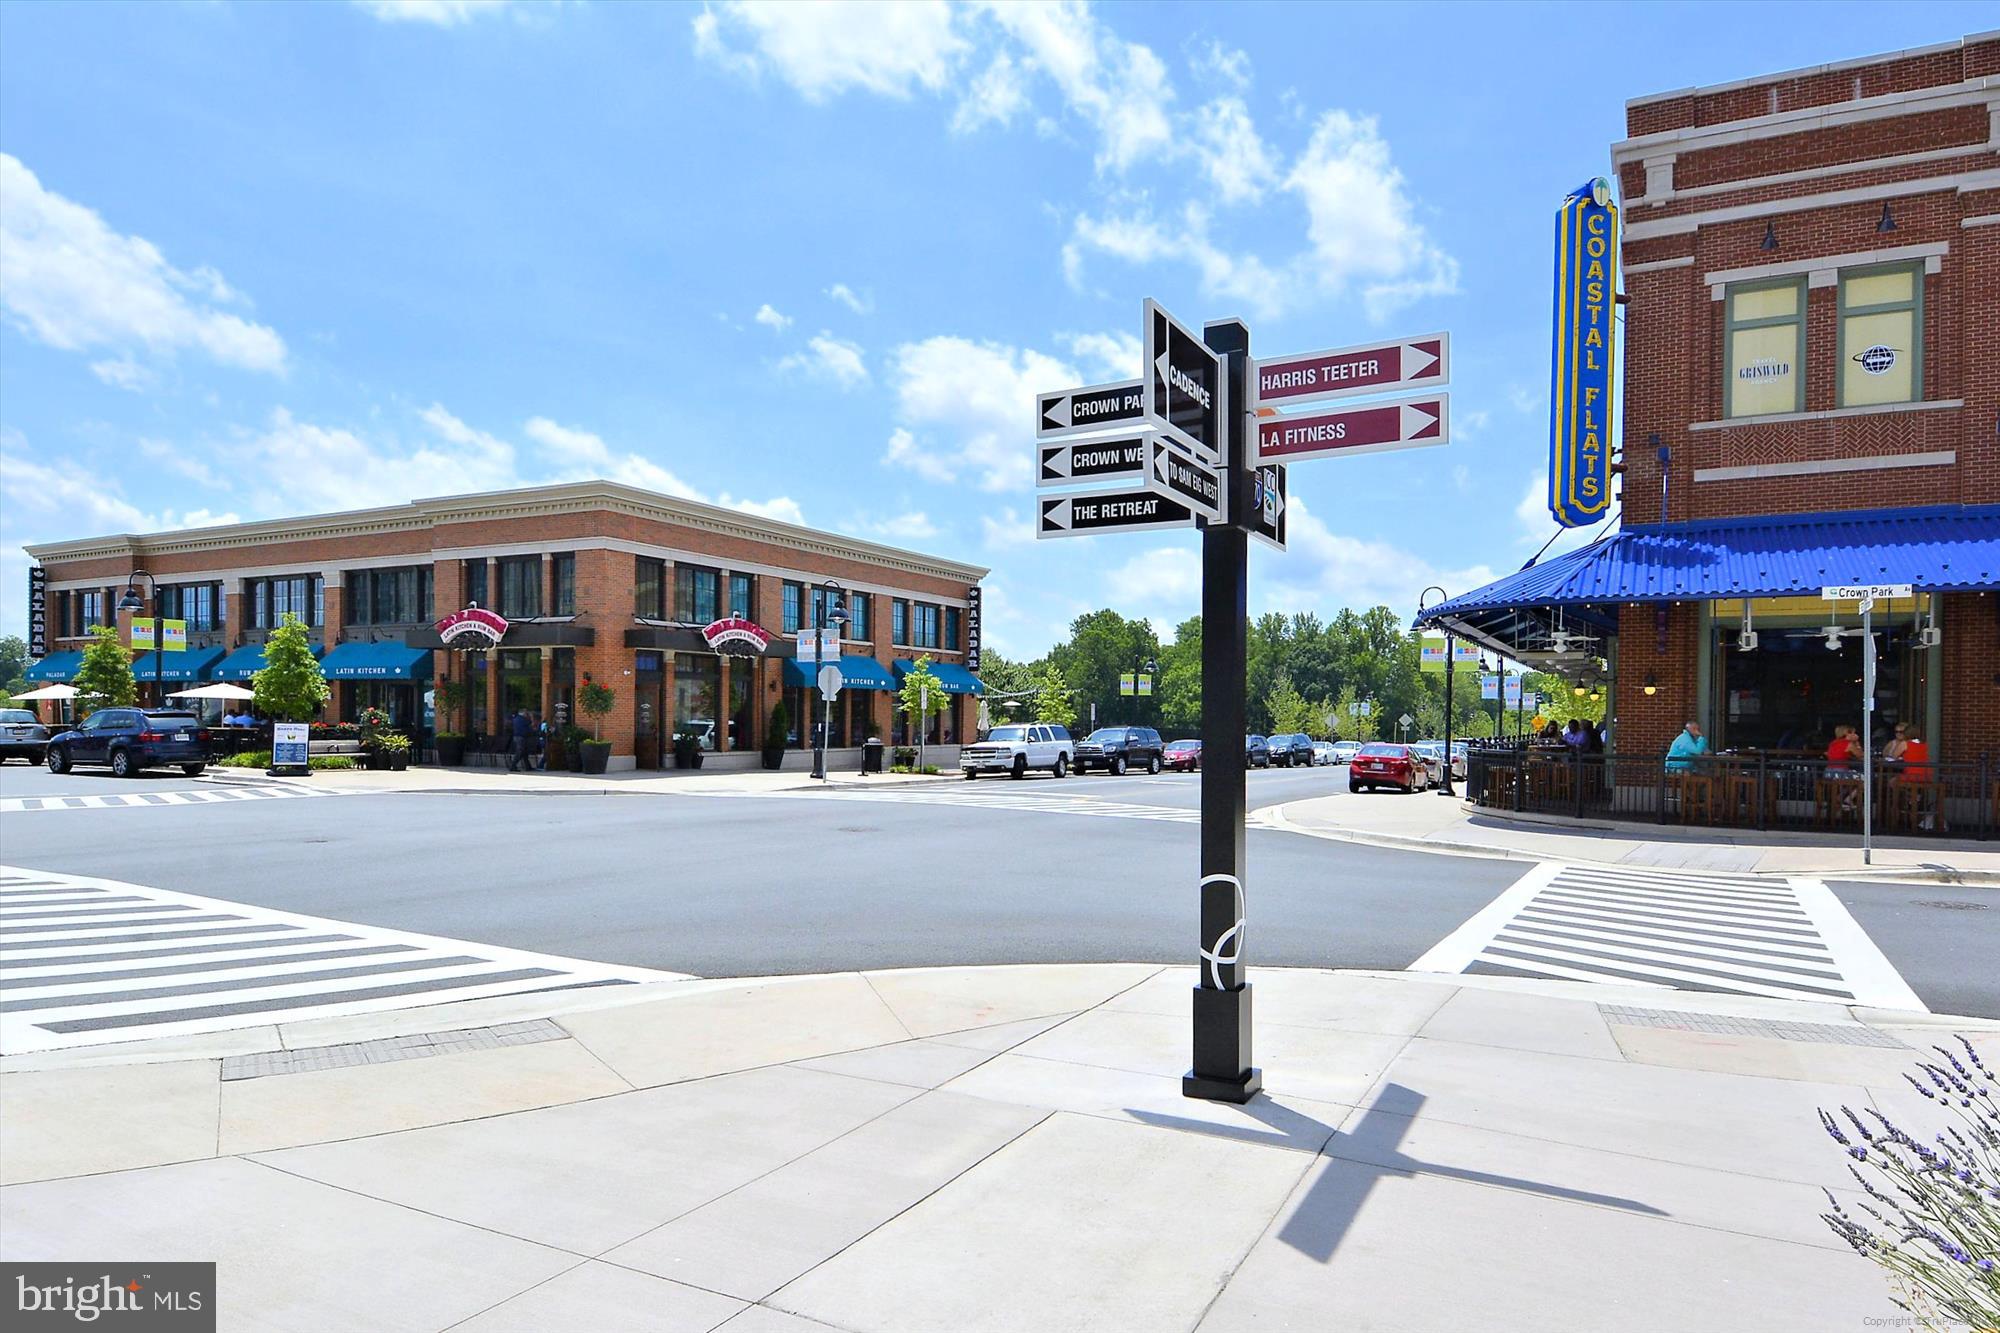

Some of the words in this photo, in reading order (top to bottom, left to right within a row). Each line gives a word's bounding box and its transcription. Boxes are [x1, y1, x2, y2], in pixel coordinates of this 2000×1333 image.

[1585, 214, 1606, 370] COASTAL
[1261, 368, 1316, 391] HARRIS
[1321, 360, 1379, 382] TEETER
[1739, 363, 1789, 379] GRISWALD
[1169, 364, 1210, 410] CADENCE
[1073, 398, 1120, 418] CROWN
[1261, 431, 1280, 448] LA
[1285, 423, 1346, 445] FITNESS
[1582, 387, 1600, 497] FLATS
[1073, 450, 1120, 468] CROWN
[1169, 461, 1178, 480] TO
[1178, 466, 1192, 488] SAM
[1192, 474, 1202, 493] EIG
[1202, 479, 1217, 501] WEST
[1074, 505, 1097, 521] THE
[1101, 500, 1159, 518] RETREAT
[1839, 587, 1869, 598] Crown
[1871, 587, 1894, 597] Park
[33, 580, 45, 654] PALADAR
[968, 600, 978, 668] PALADAR
